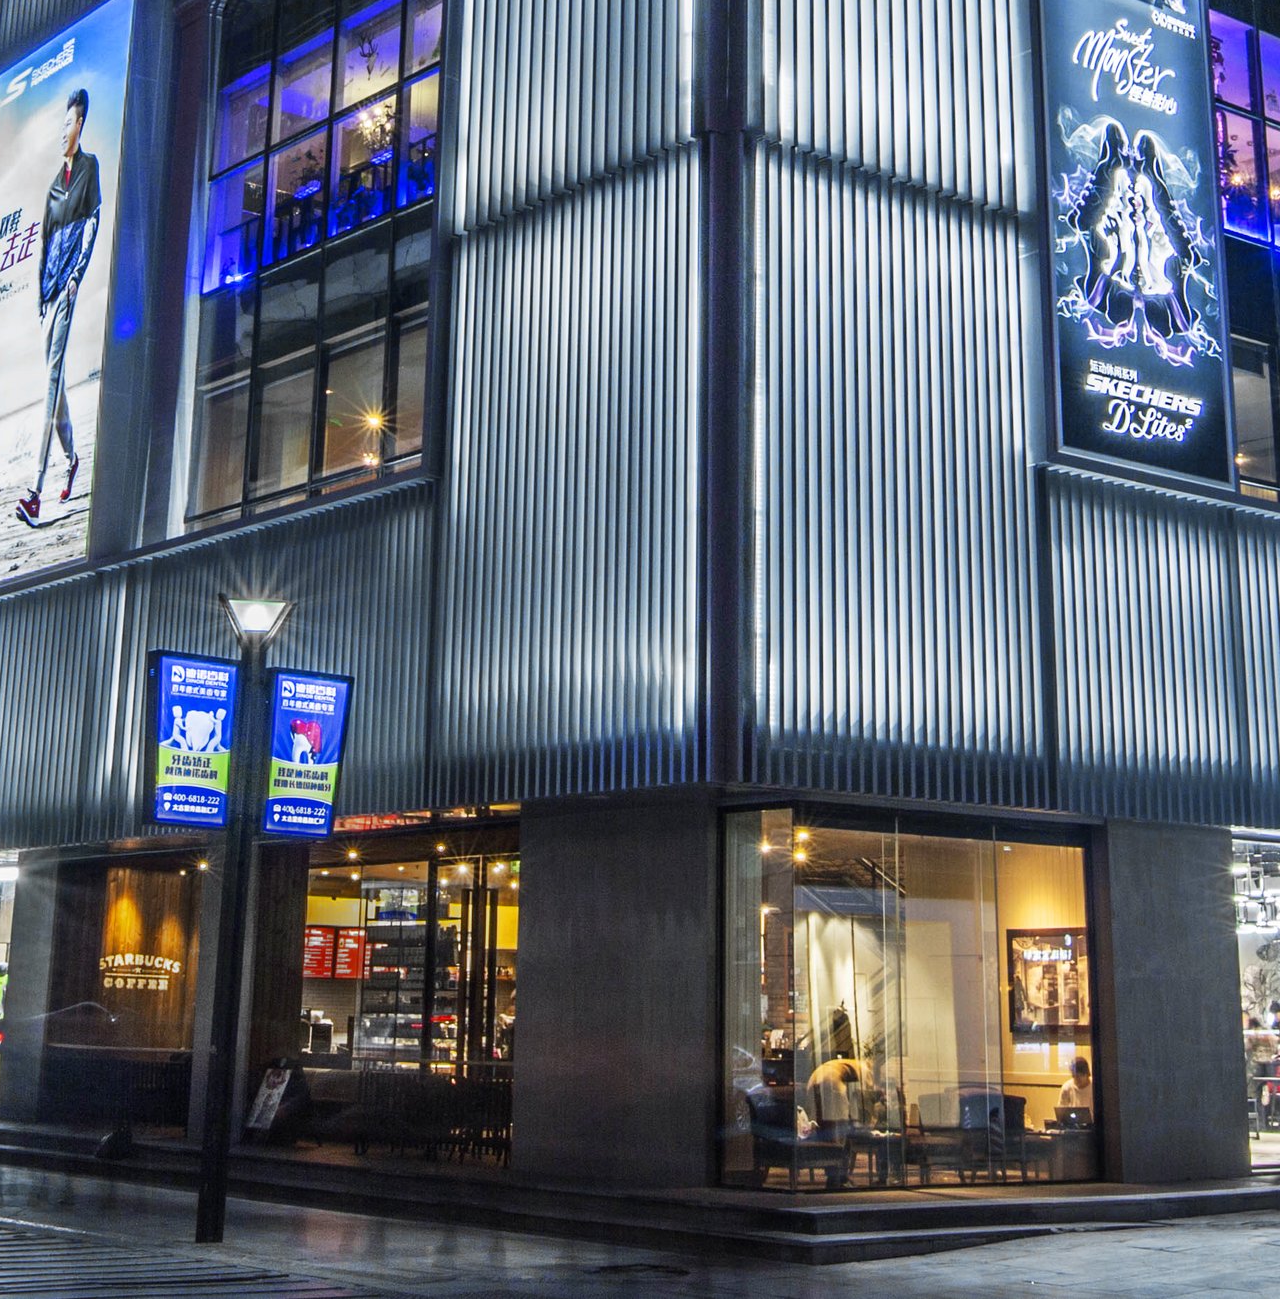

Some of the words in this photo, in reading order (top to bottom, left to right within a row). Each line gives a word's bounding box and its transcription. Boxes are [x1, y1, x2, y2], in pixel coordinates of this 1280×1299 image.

[1085, 373, 1203, 417] SKECHERS
[173, 793, 220, 805] 400-6818-222
[99, 953, 182, 973] STARBUCKS
[103, 977, 169, 991] COFFEE
